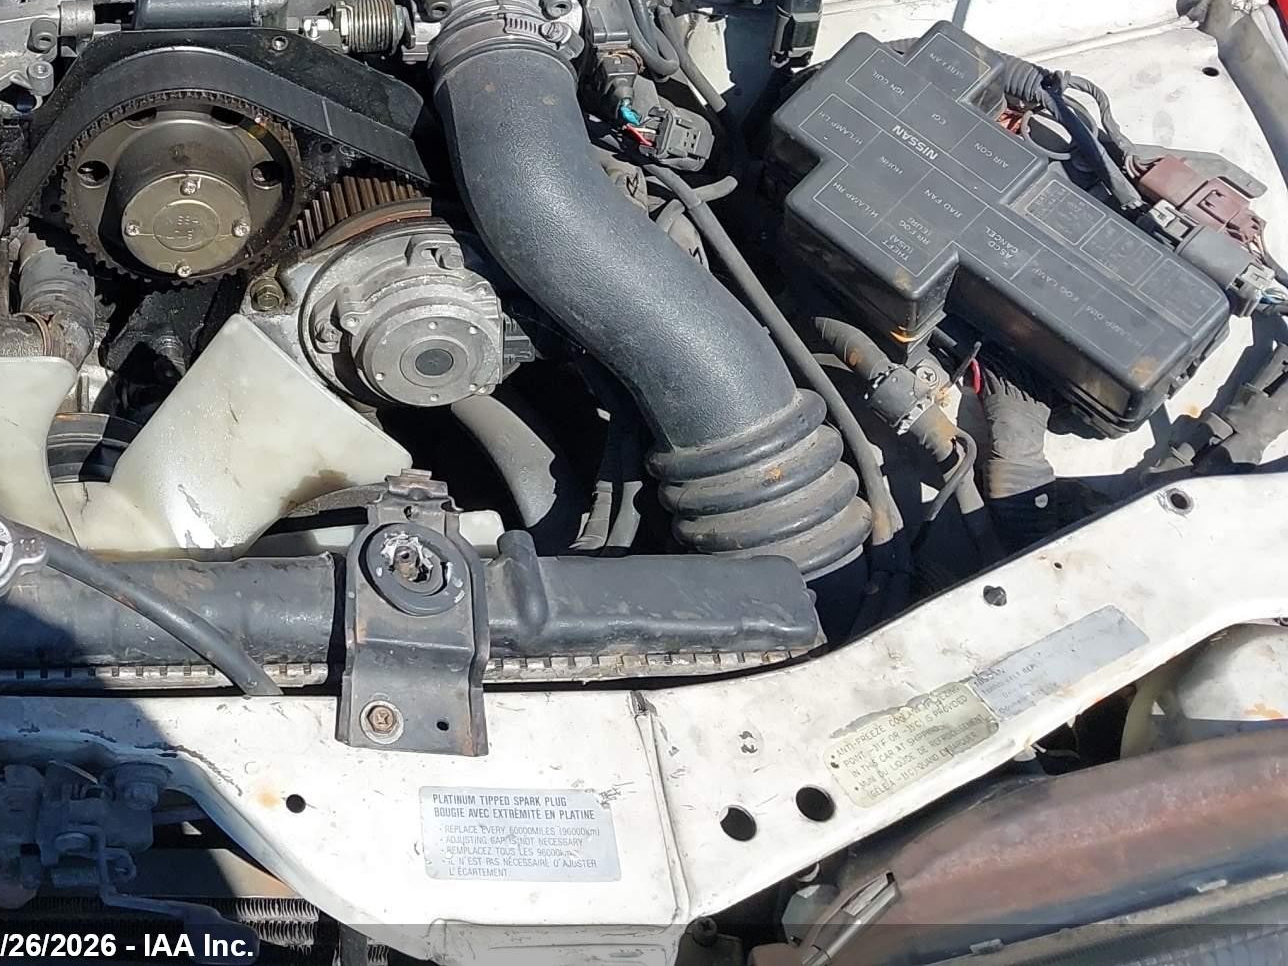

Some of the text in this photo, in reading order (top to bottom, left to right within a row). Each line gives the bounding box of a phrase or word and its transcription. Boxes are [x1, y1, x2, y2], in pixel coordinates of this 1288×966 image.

[890, 123, 939, 161] NISSAN
[973, 141, 1009, 168] AIR CON
[880, 237, 910, 260] THEFT
[888, 232, 914, 254] (USA)
[982, 224, 1019, 254] CANCEL
[986, 238, 1013, 260] ASCD
[843, 750, 865, 768] POINT
[932, 694, 967, 718] PROVIDED
[878, 748, 894, 762] CAR
[432, 794, 567, 807] PLATINUM TIPPED SPARK PLUG
[434, 807, 465, 818] BOUGIE
[469, 808, 490, 818] AVEC
[544, 809, 556, 819] EN
[559, 809, 596, 820] PLATINE
[444, 825, 478, 834] REPLACE
[481, 825, 506, 835] EVERY
[445, 835, 487, 845] ADJUSTING
[538, 837, 583, 847] NECESSARY
[495, 847, 516, 856] TOUS
